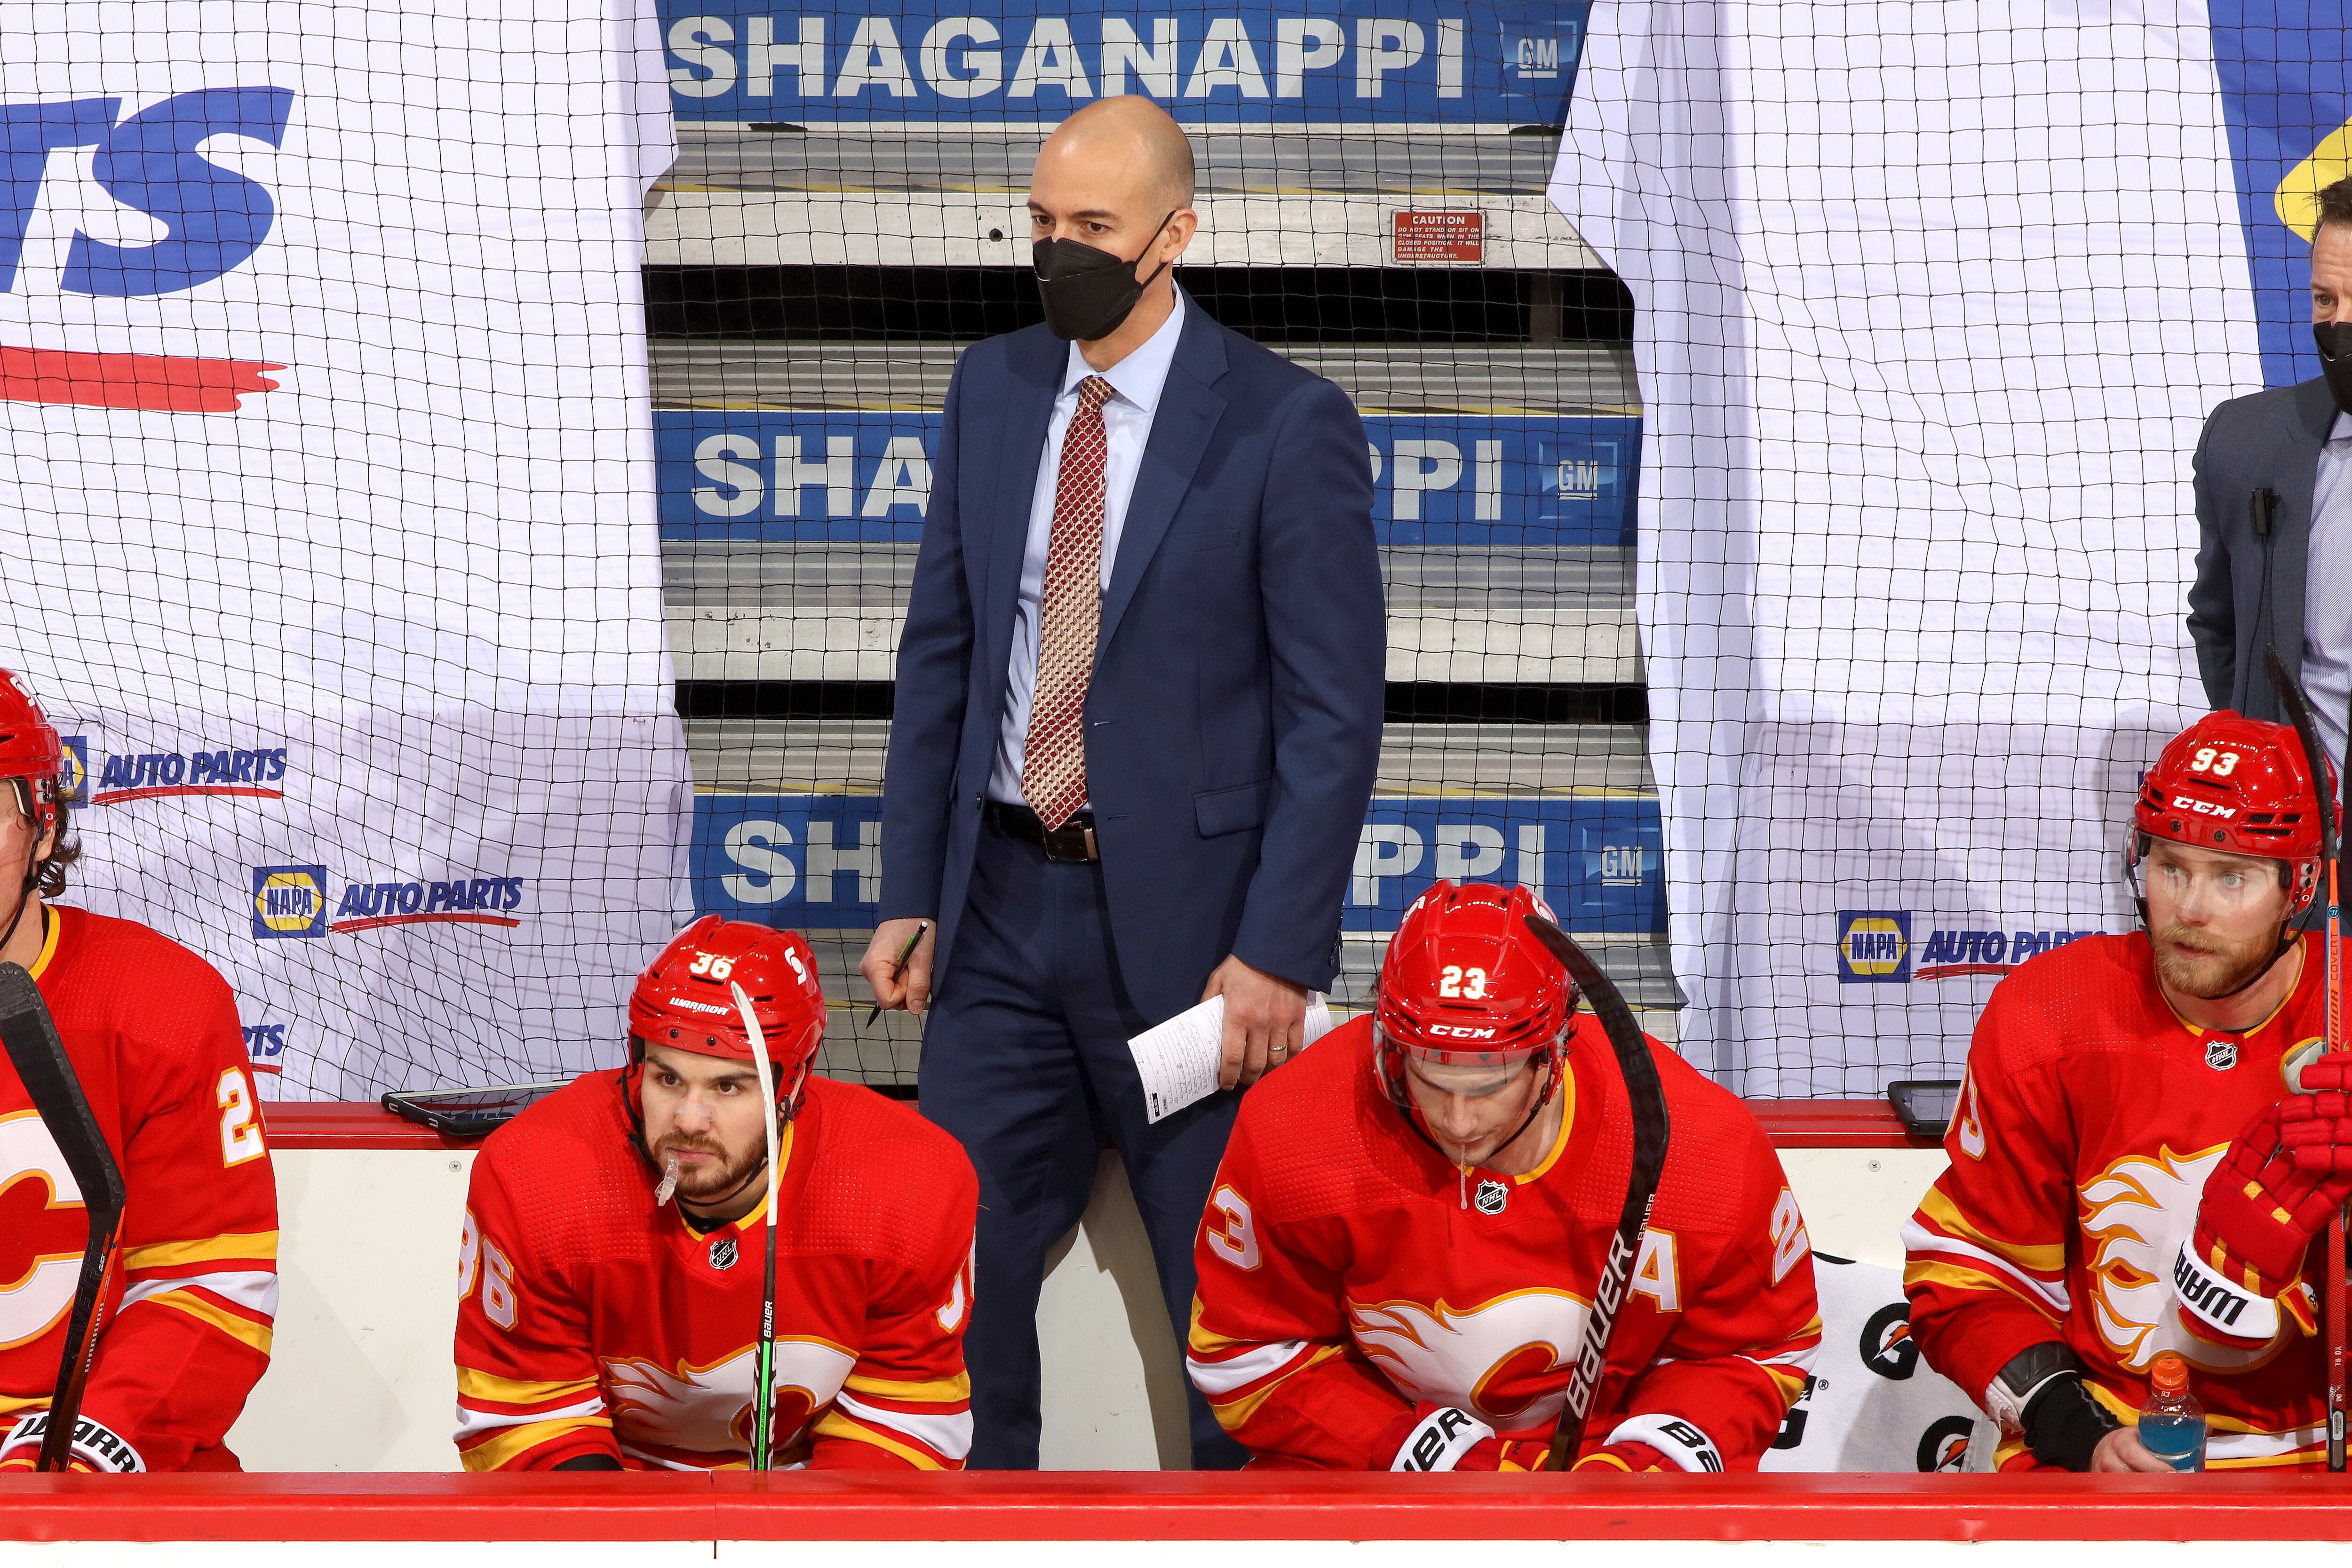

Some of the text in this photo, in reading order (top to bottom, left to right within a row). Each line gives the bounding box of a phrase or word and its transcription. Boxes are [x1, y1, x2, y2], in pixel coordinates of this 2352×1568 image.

[666, 16, 1463, 99] SHAGANAPPI
[1517, 36, 1557, 70] GM
[1413, 216, 1465, 225] CAUTION
[1558, 460, 1598, 491] GM
[98, 753, 186, 789] AUTO
[189, 748, 287, 786] PARTS
[2191, 748, 2240, 777] 93
[2172, 796, 2237, 820] CCM
[1601, 845, 1643, 877] GM
[267, 876, 523, 917] NAPA AUTO PARTS
[1851, 933, 1898, 960] NAPA
[1920, 931, 2007, 963] AUTO
[689, 950, 736, 980] 36
[1439, 965, 1486, 1000] 23
[669, 996, 729, 1016] WARRIOR
[1429, 1024, 1497, 1039] CCM
[216, 1066, 267, 1169] 2
[1206, 1183, 1263, 1273] 3
[1626, 1226, 1683, 1313] A
[763, 1300, 773, 1338] BAUER
[1566, 1230, 1634, 1420] BAUER
[84, 1302, 104, 1374] WARRIOR
[14, 1416, 141, 1472] WARR
